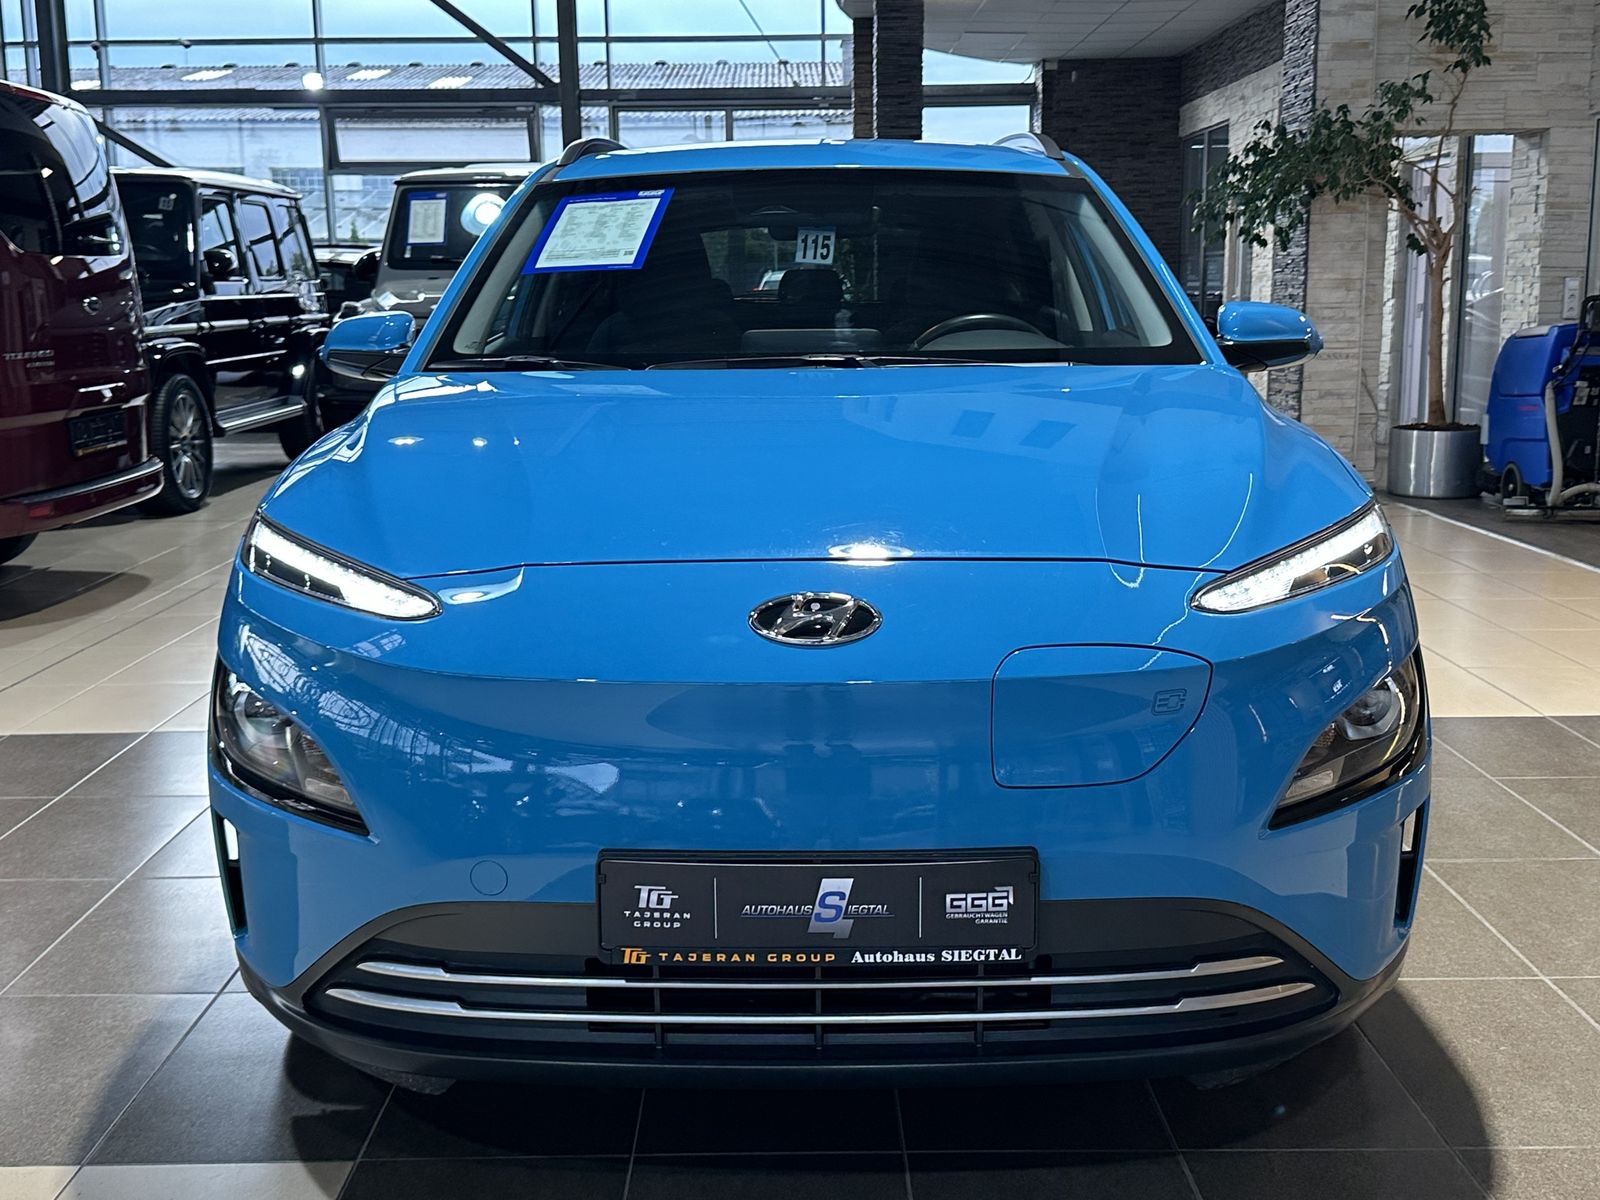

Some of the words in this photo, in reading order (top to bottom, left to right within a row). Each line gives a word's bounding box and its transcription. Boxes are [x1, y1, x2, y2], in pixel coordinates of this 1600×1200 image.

[801, 234, 832, 261] 115
[945, 891, 1008, 913] GGG
[623, 910, 691, 919] TAJERAN
[741, 905, 813, 916] AUTOHAUS
[633, 920, 681, 928] GROUP
[658, 952, 755, 962] TAJERAN
[767, 953, 836, 962] GROUP
[851, 950, 935, 963] Autohaus
[941, 948, 1022, 962] SIEGTAL
